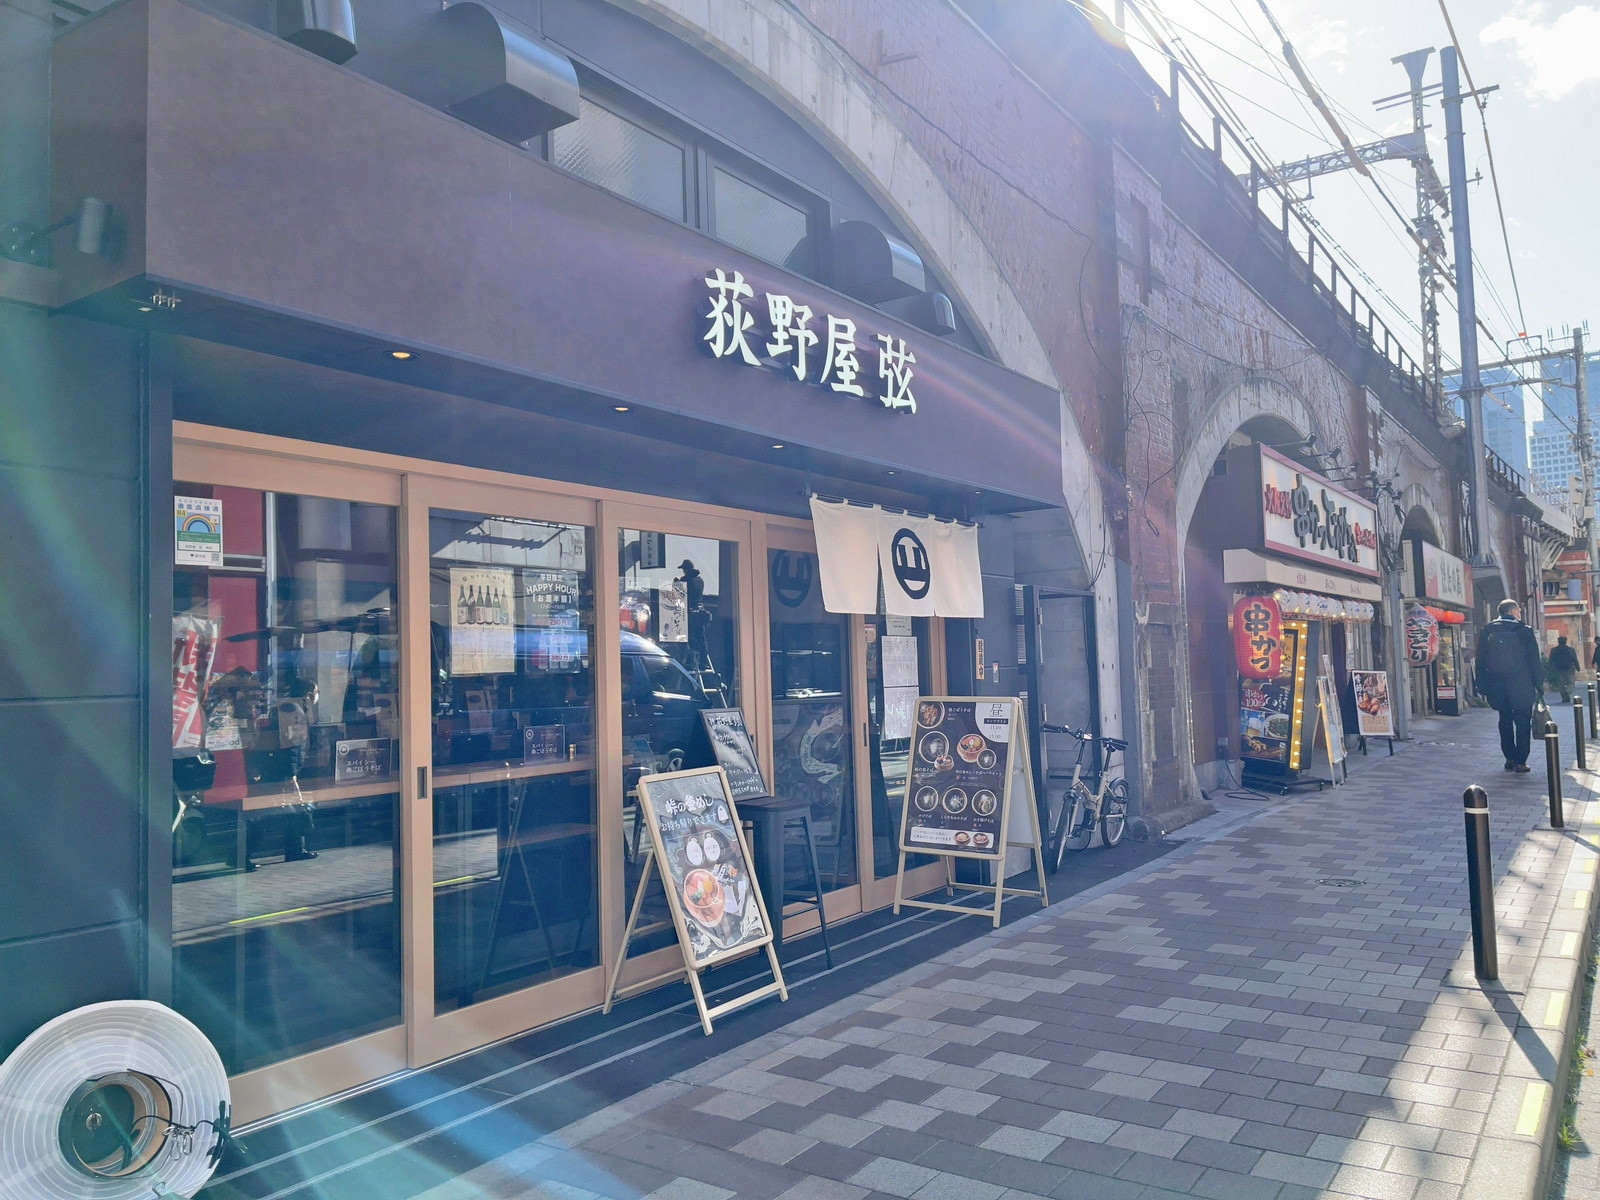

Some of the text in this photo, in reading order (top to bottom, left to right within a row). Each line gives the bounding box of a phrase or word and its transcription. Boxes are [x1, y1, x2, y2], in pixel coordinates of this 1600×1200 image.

[540, 573, 563, 582] 平日限定
[525, 583, 577, 597] HAPPY HOUR
[1243, 603, 1277, 670] 串かつ
[1406, 616, 1432, 662] やきとり
[989, 703, 1003, 718] 昼
[664, 794, 714, 816] 峠の釜めし
[660, 812, 718, 832] お持ち帰りできます
